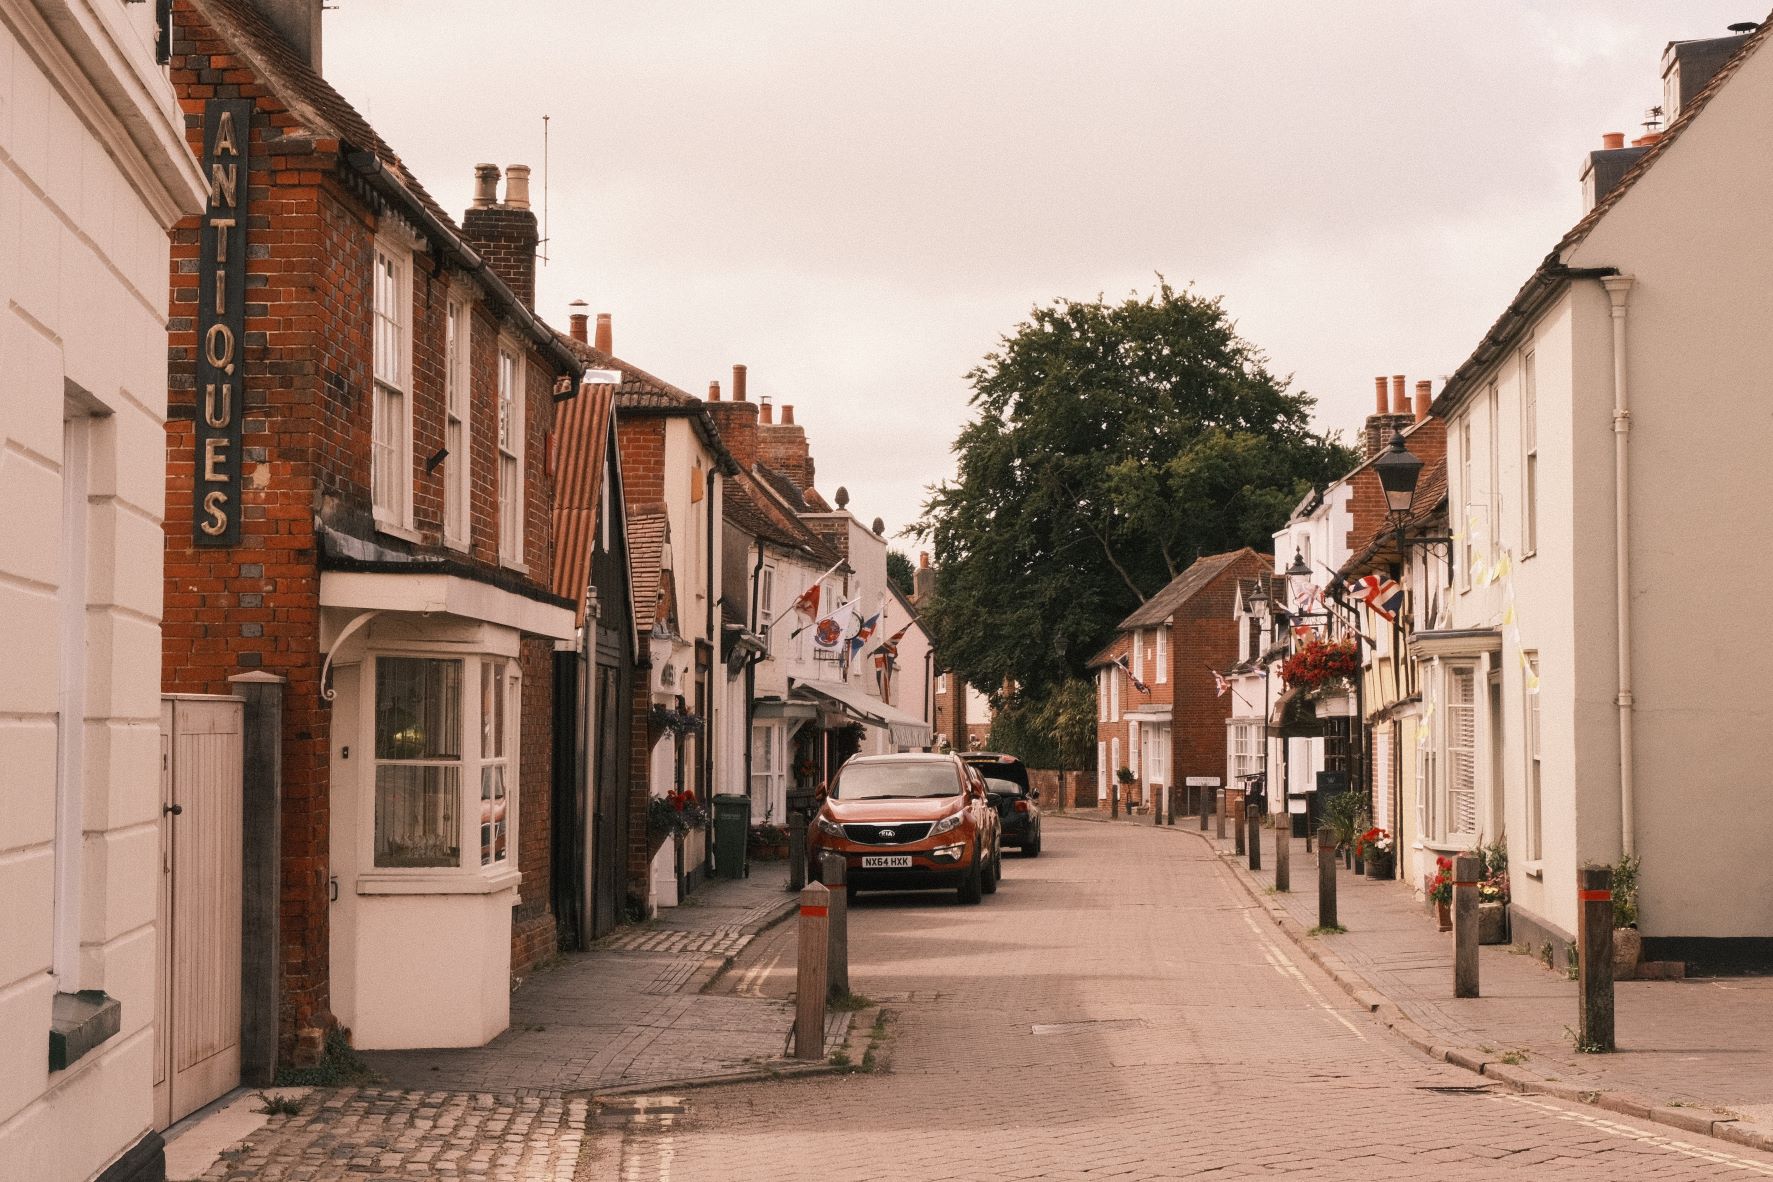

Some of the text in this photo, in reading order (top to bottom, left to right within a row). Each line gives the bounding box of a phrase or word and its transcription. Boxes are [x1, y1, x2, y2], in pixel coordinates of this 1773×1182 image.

[201, 111, 238, 535] ANTIQUES
[865, 857, 909, 867] NX64 HXK
